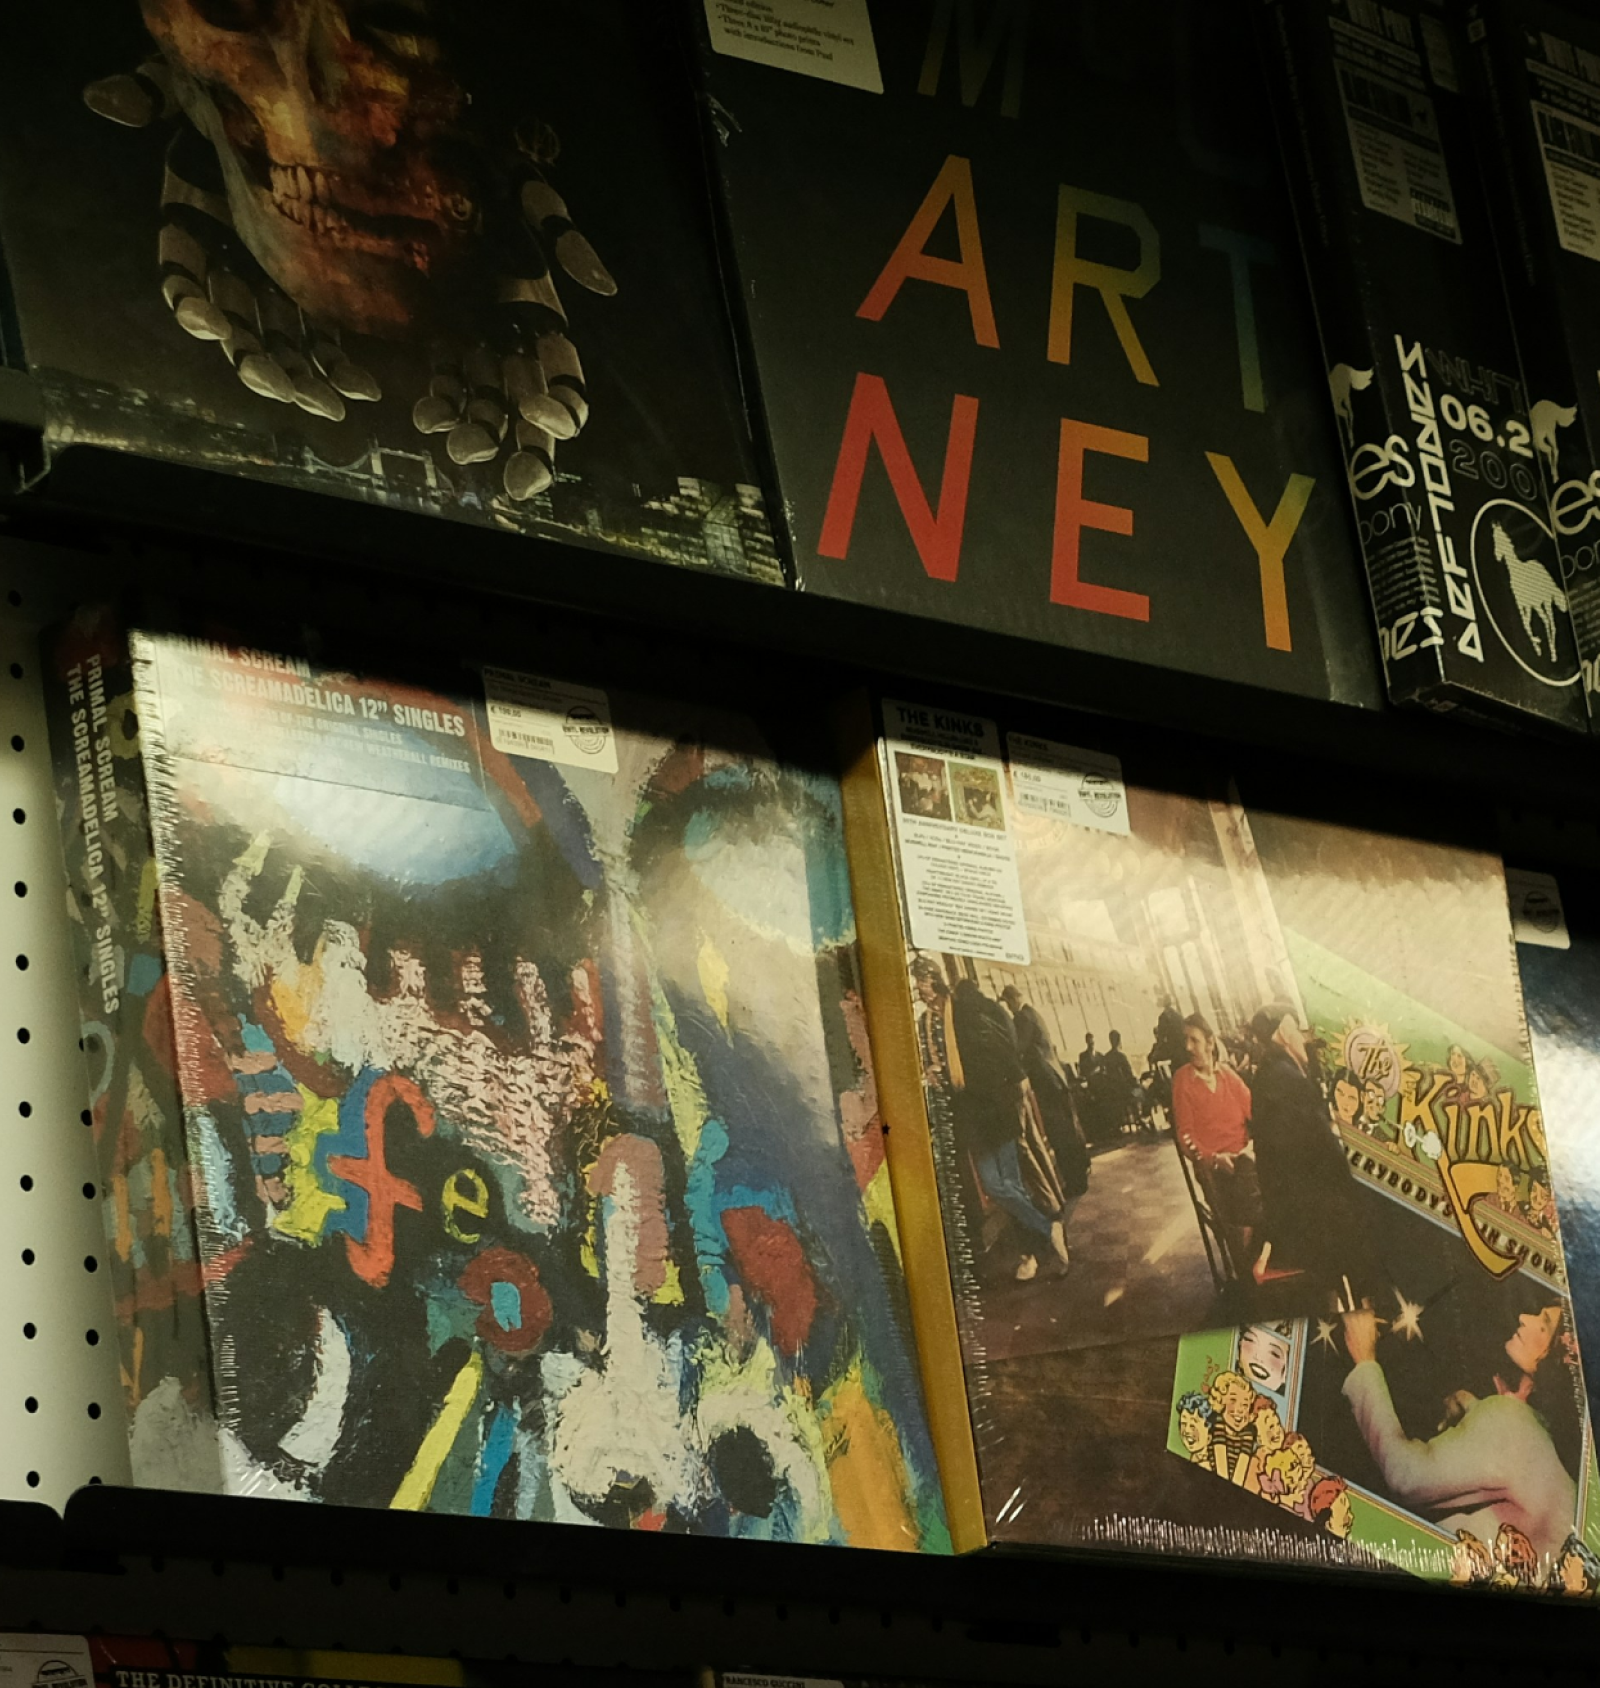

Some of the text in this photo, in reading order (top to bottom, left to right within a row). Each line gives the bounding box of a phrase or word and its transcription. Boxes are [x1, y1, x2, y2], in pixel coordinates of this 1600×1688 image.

[1439, 392, 1534, 459] 06.2
[815, 370, 1317, 653] NEY
[66, 662, 78, 705] THE
[239, 648, 311, 678] SCREAM
[86, 652, 119, 823] PRIMAL SCREAM
[212, 671, 356, 716] SCREAMADELICA
[393, 704, 466, 738] SINGLES
[896, 707, 985, 737] THE KINKS
[71, 707, 105, 881] SCREAMADELICA
[96, 924, 120, 1015] SINGLES
[1359, 1046, 1393, 1077] The
